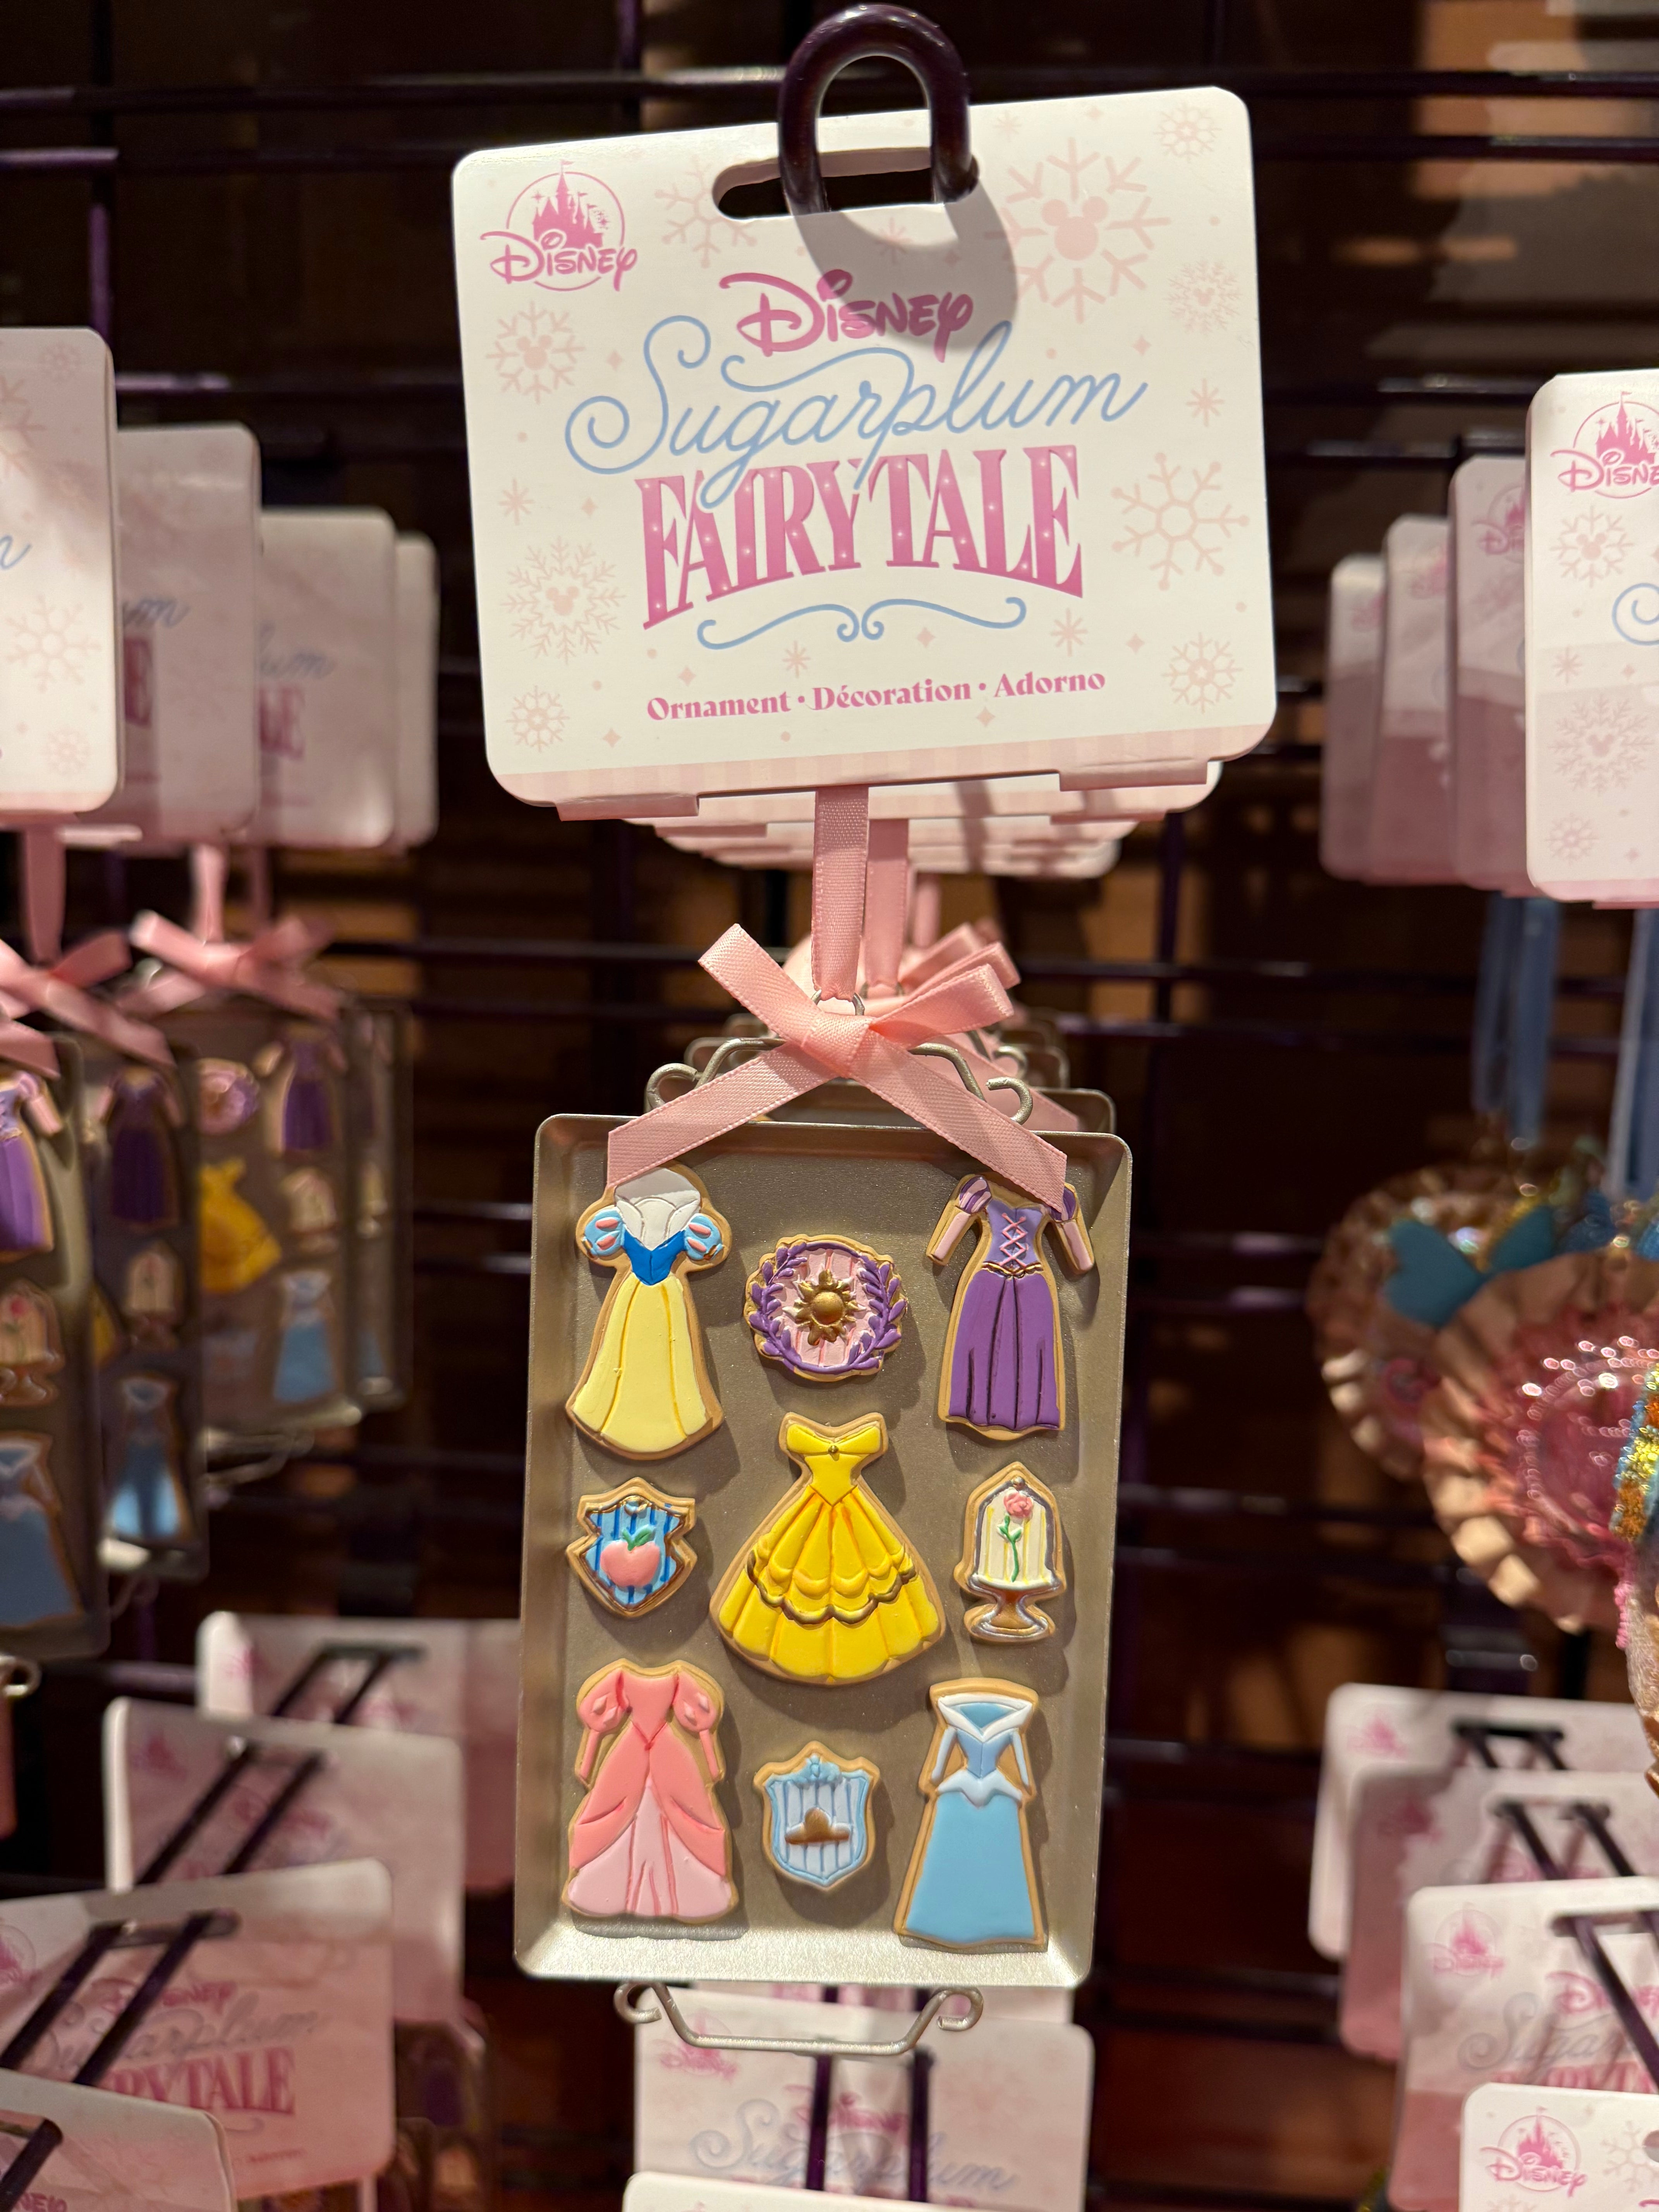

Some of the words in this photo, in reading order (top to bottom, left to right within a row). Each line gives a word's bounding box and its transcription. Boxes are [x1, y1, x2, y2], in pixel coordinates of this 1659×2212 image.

[479, 230, 638, 292] Disney
[718, 268, 973, 362] Disney
[564, 304, 1148, 509] Sugarplum
[1549, 448, 1659, 493] Disne
[634, 444, 1084, 630] FAIRYTALE
[646, 690, 791, 721] Ornament
[807, 678, 971, 711] Décoration
[993, 672, 1106, 697] Adorno
